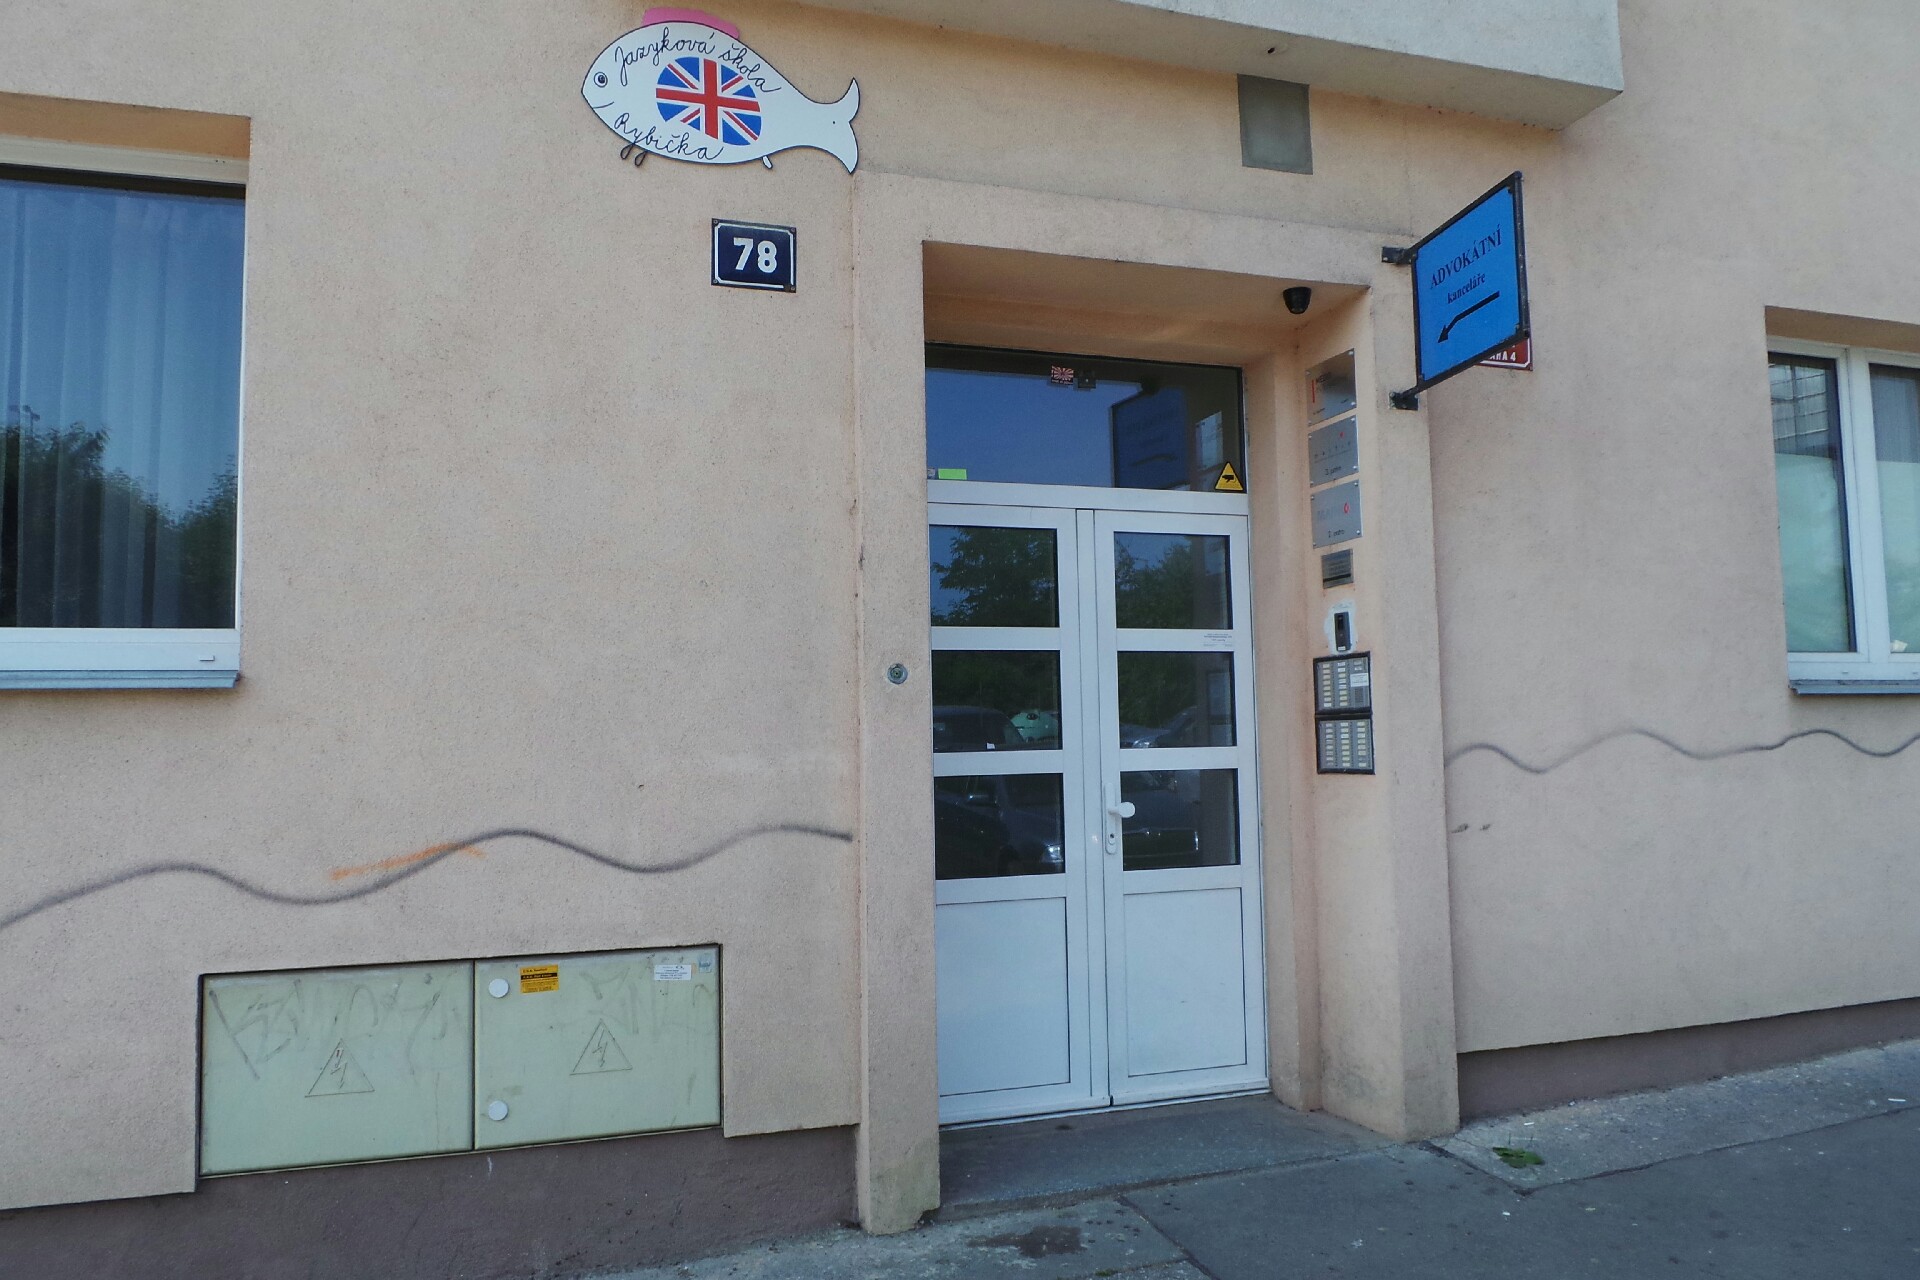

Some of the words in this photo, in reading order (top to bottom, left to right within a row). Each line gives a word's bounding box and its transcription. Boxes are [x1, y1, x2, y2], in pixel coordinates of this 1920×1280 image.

[615, 26, 717, 87] Jazyková
[718, 43, 782, 93] škola
[613, 112, 724, 161] Rybička
[733, 237, 778, 274] 78
[1430, 224, 1502, 290] ADVOKÁTNÍ
[1447, 271, 1487, 304] kanceláře
[1510, 351, 1517, 362] 4
